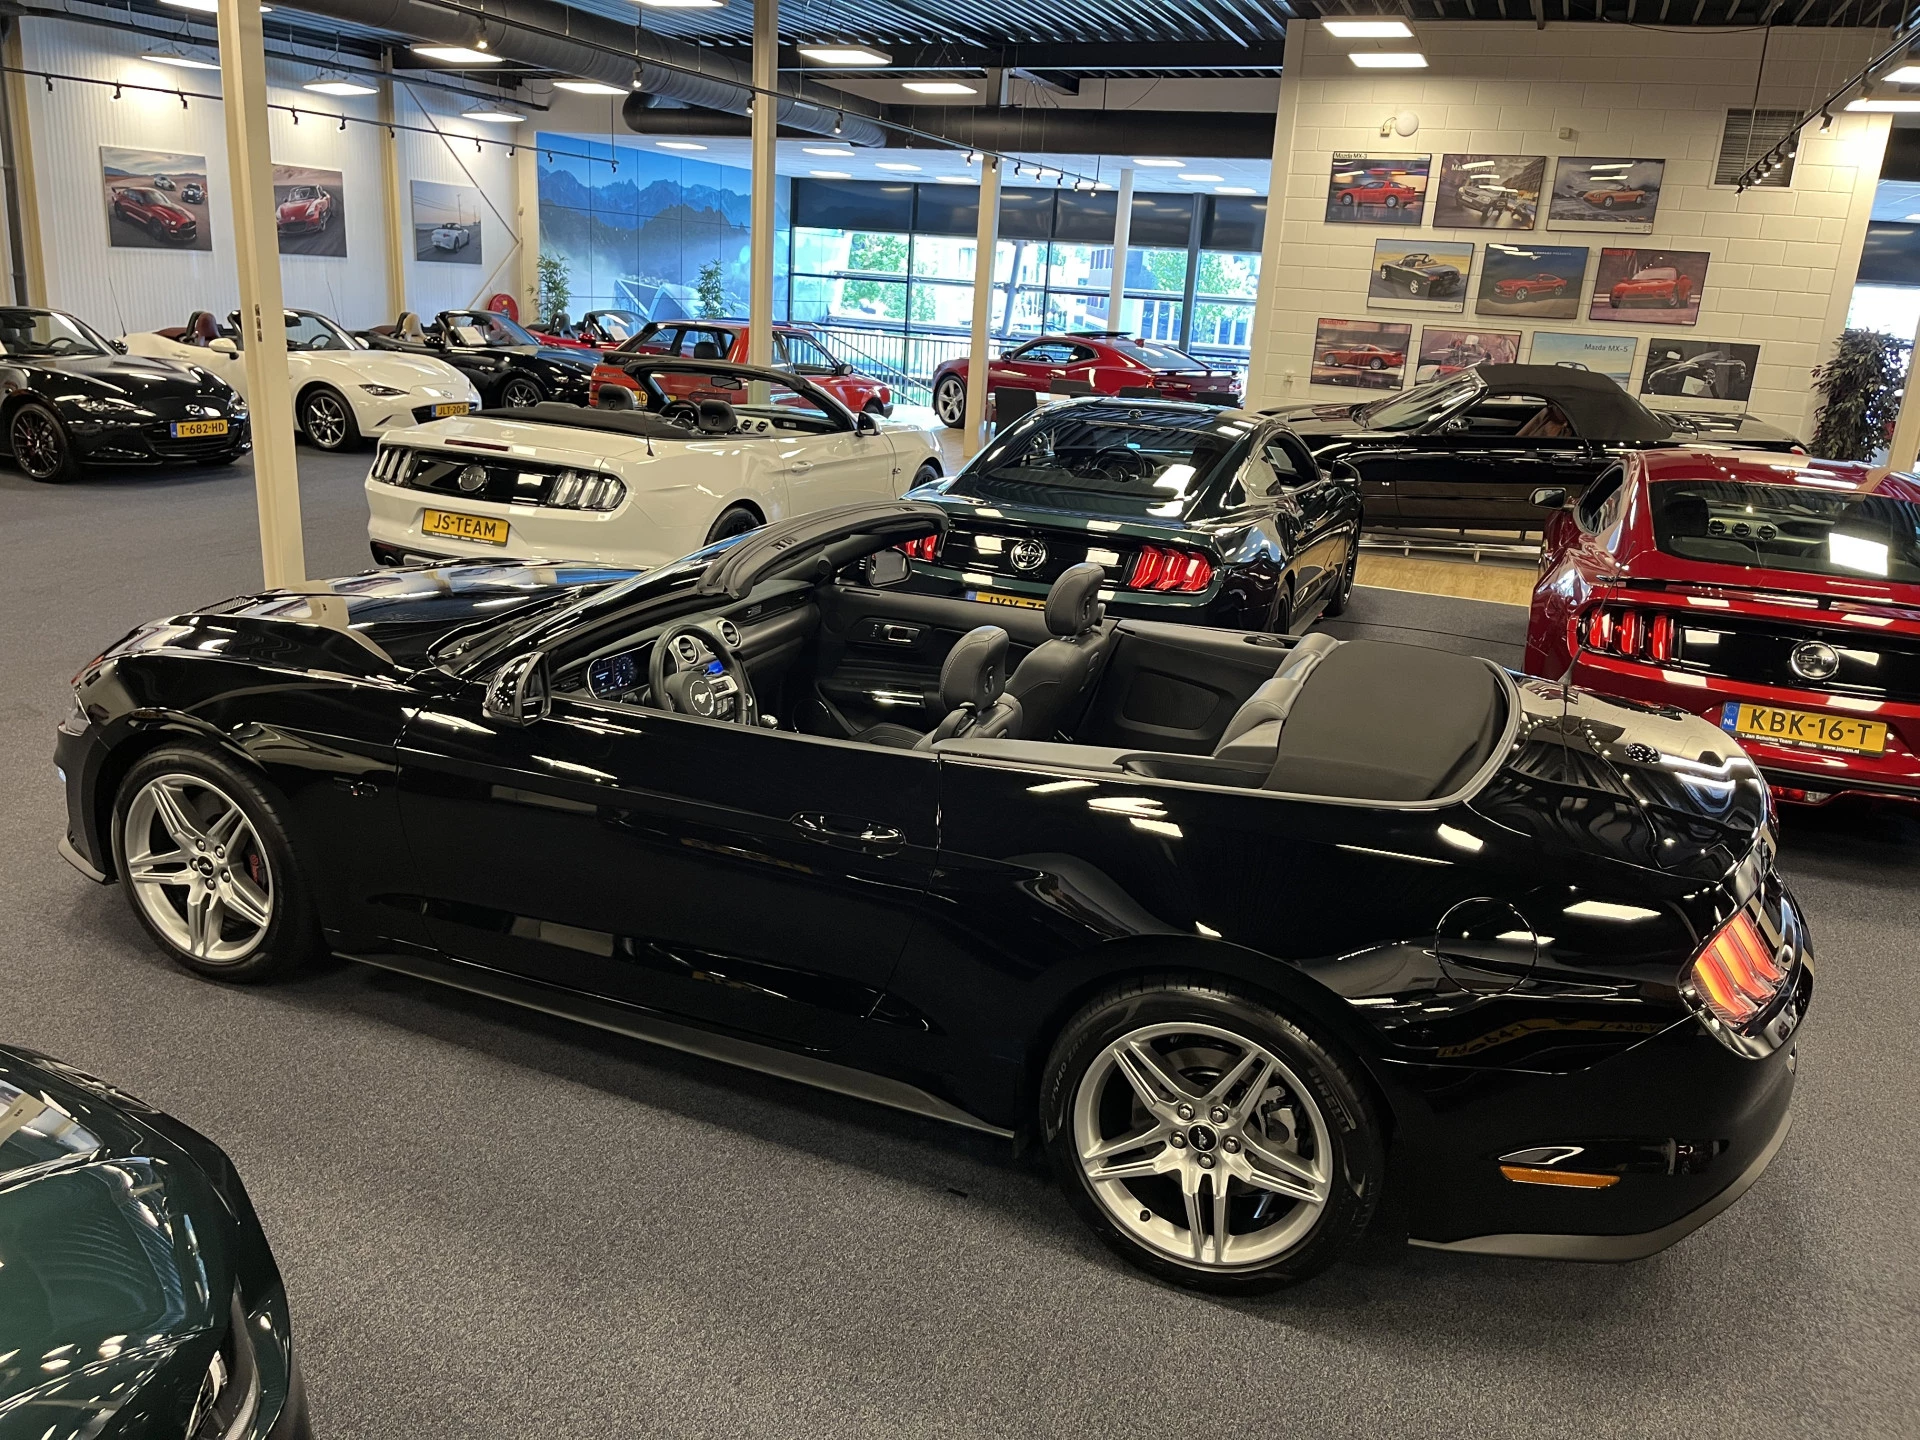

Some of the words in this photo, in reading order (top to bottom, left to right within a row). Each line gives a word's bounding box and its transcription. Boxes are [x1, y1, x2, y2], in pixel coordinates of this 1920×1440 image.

[1584, 343, 1606, 351] Mazda
[1607, 344, 1629, 352] MX-5
[180, 423, 225, 435] T-682-HD
[433, 514, 497, 538] JS-TEAM
[1723, 717, 1735, 727] NL
[1749, 708, 1873, 745] KBK-16-T
